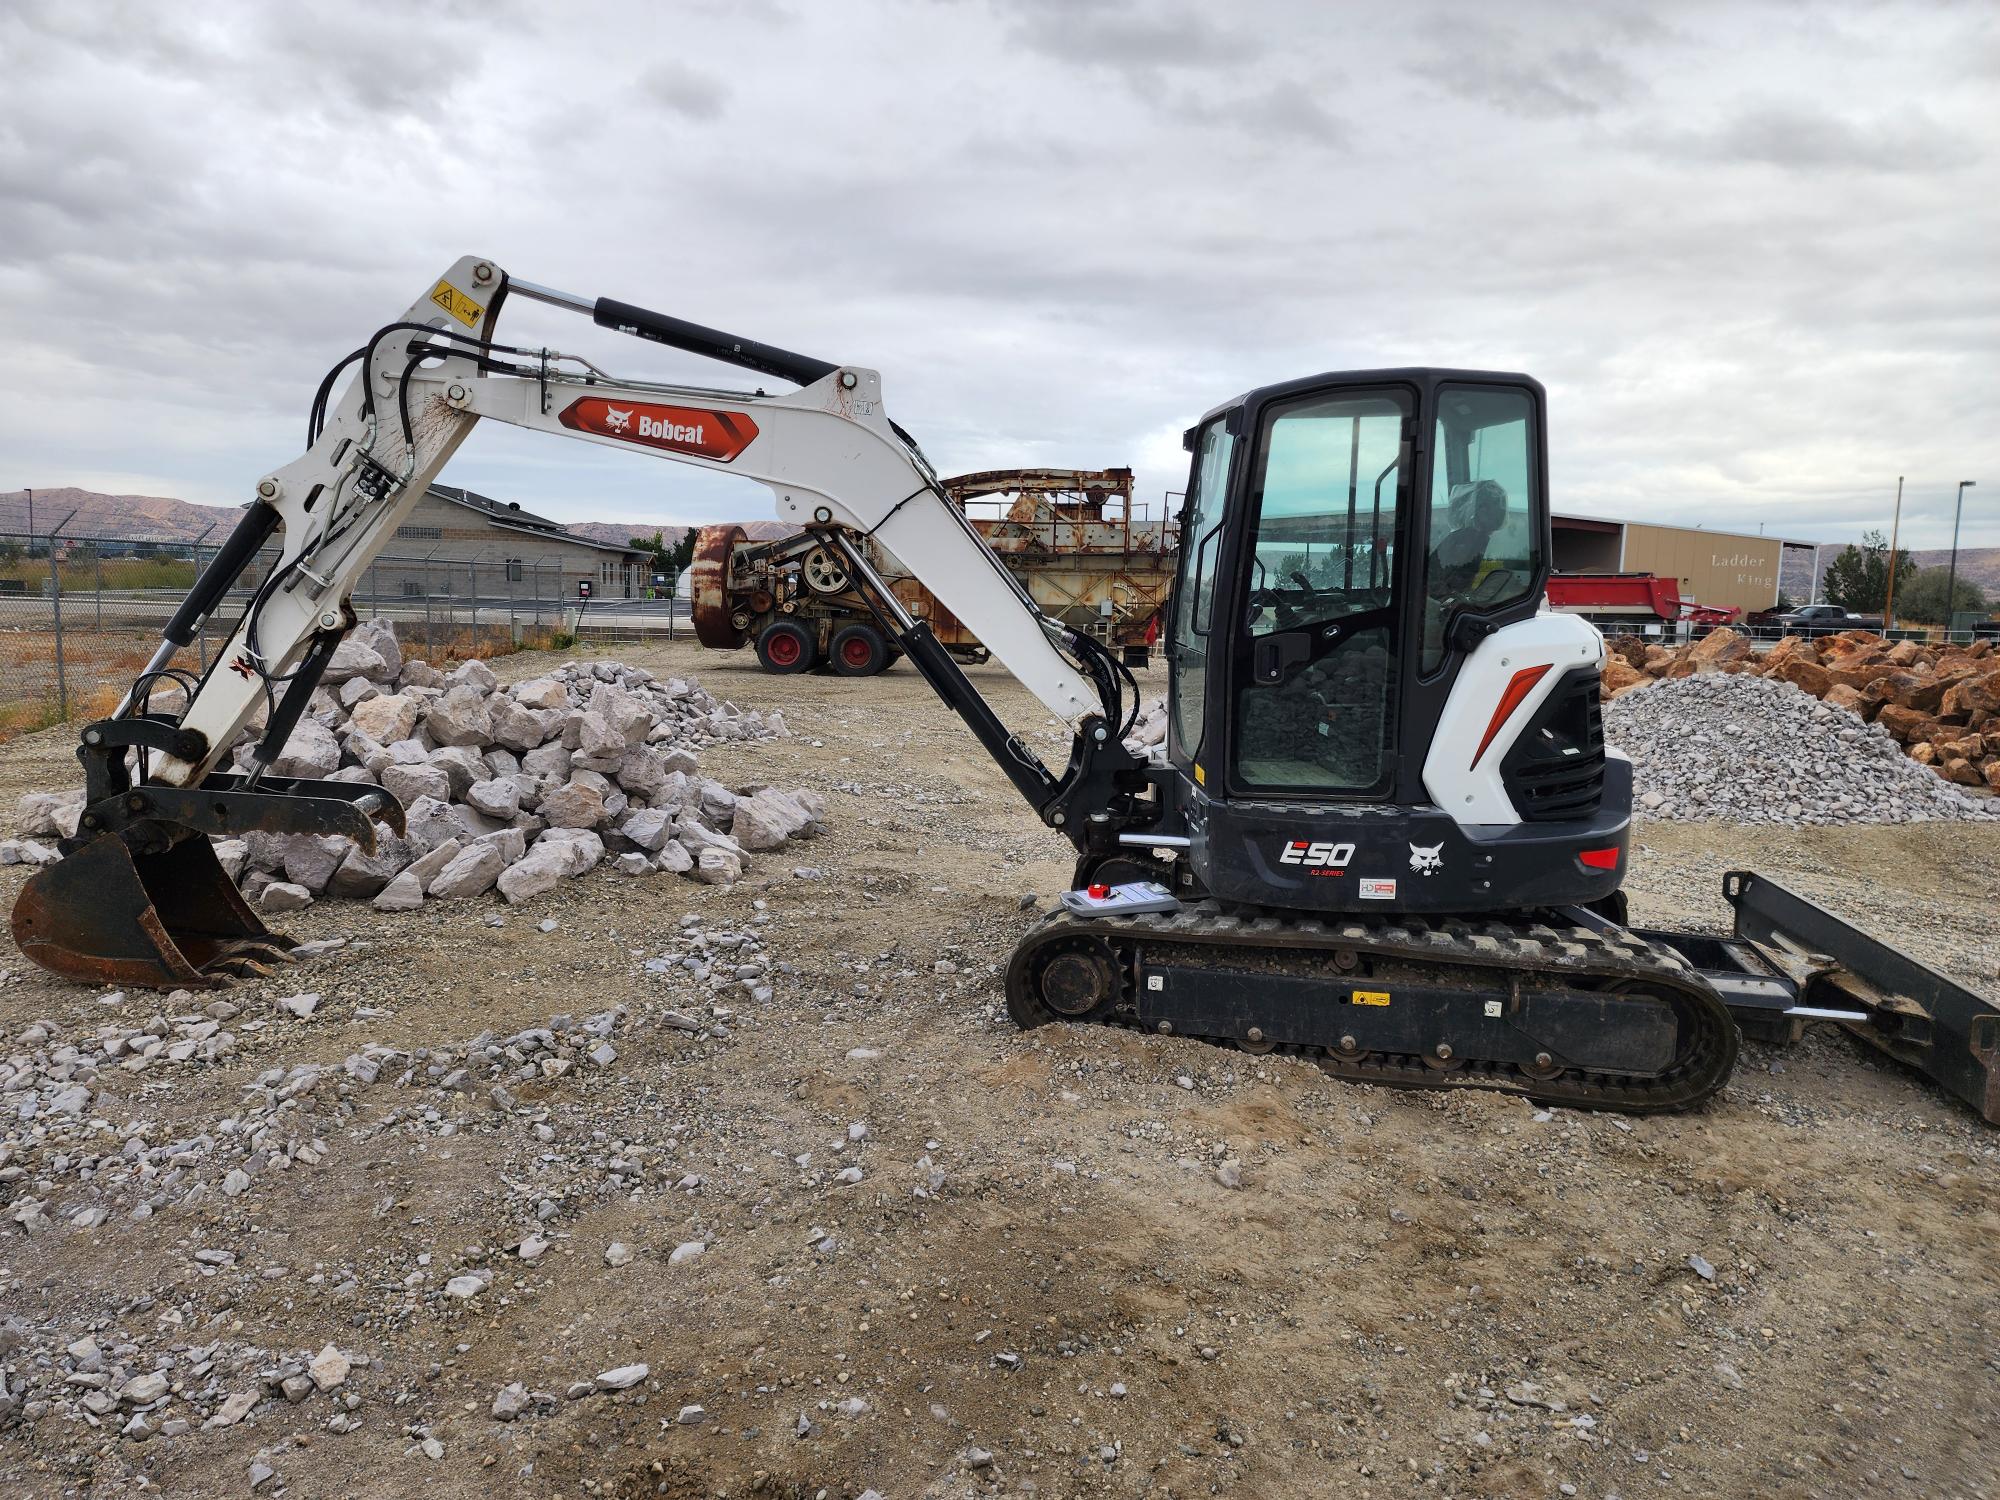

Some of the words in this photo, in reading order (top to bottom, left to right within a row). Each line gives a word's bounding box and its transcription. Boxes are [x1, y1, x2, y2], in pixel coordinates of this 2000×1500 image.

[638, 415, 704, 445] Bobcat
[1711, 554, 1766, 567] Ladder
[1737, 573, 1773, 588] King
[1279, 841, 1356, 867] E50
